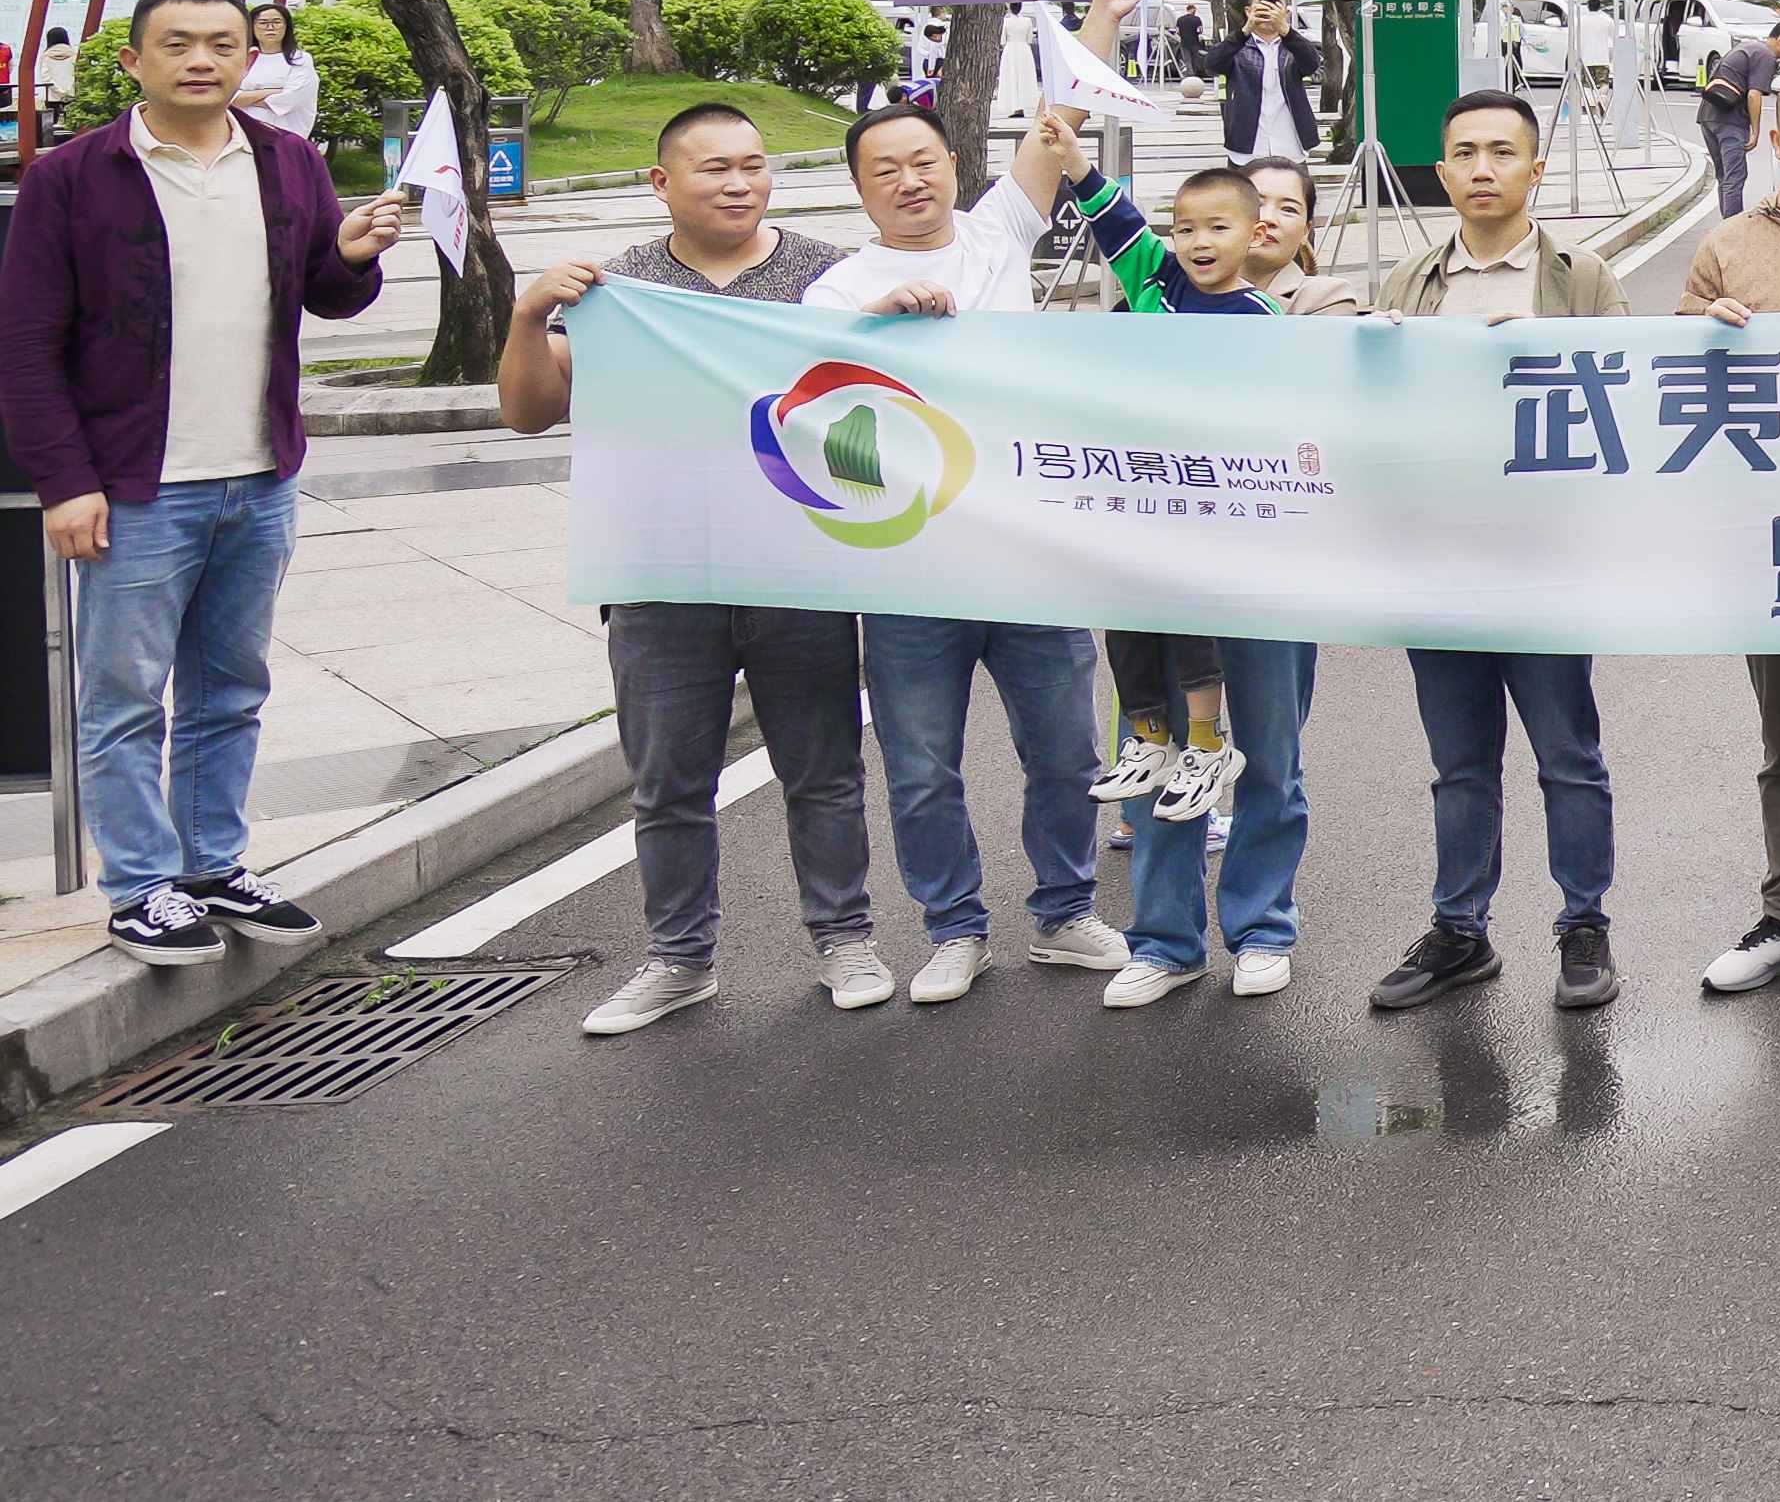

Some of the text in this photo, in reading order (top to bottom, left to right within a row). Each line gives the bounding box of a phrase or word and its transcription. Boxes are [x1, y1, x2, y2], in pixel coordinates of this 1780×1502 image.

[1012, 441, 1220, 488] 1号风景道
[1220, 456, 1288, 475] WUYI
[1227, 477, 1335, 495] MOUNTAINS
[1072, 495, 1277, 519] 武夷山国家公园
